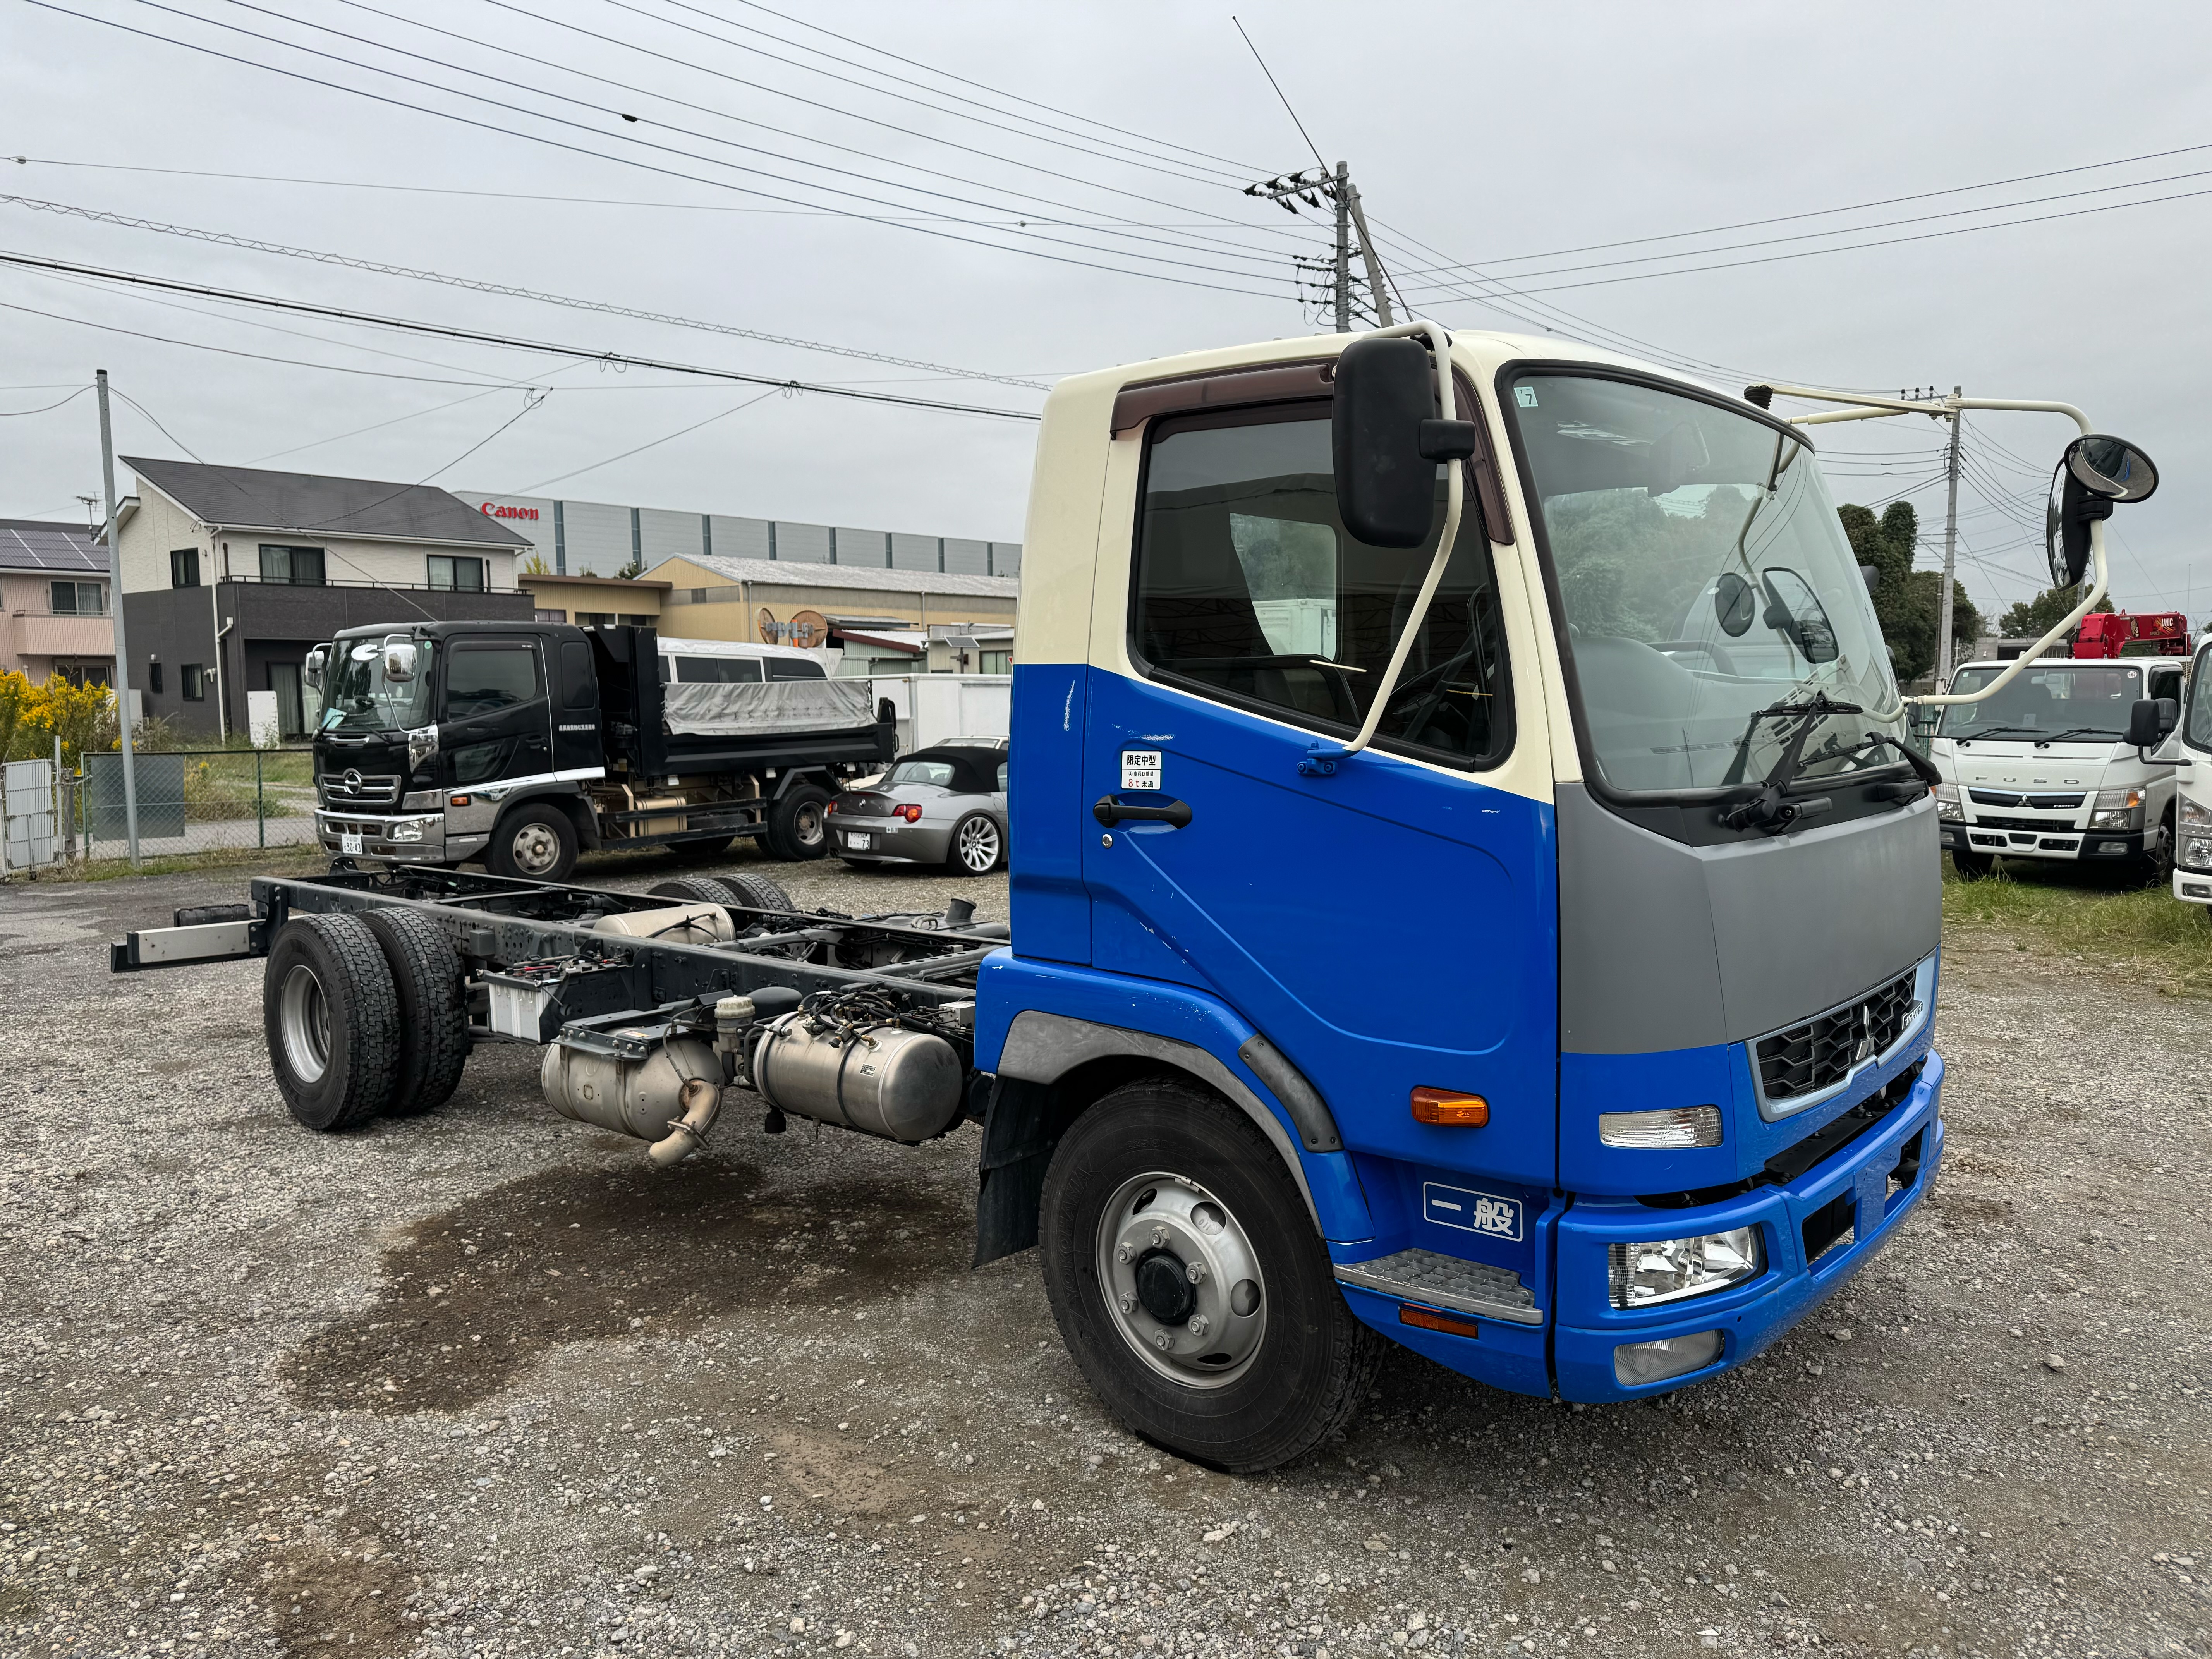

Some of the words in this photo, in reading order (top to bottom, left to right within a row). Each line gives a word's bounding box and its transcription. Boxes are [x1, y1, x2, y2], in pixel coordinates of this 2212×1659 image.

[1525, 393, 1532, 405] 7
[481, 502, 539, 520] Canon
[2162, 618, 2173, 627] UNIC
[1127, 754, 1156, 766] 限定中型
[1976, 776, 2080, 784] FUSO
[1431, 1198, 1514, 1235] 一般
[1058, 1166, 1093, 1304] YOKOHAMA
